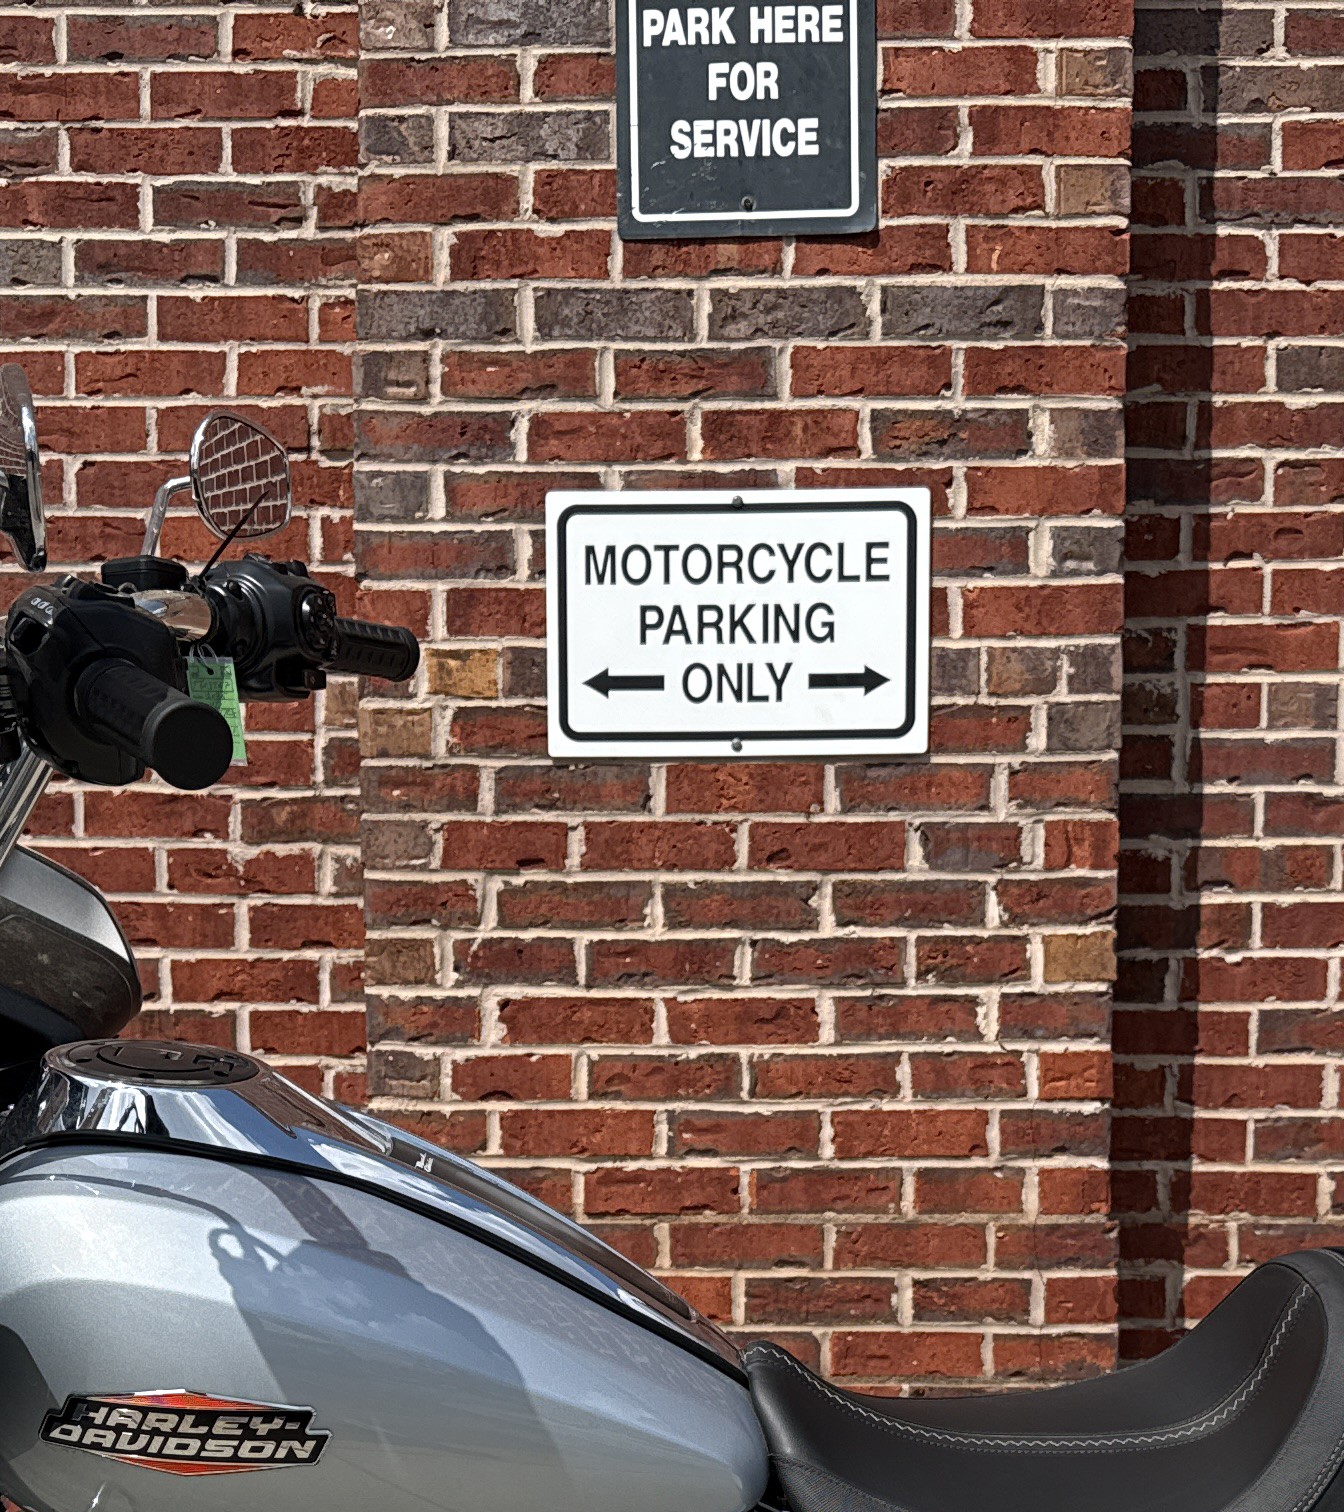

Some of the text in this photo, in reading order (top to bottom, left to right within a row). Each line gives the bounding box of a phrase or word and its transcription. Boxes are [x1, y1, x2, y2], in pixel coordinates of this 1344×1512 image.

[642, 5, 844, 47] PARK HERE
[708, 61, 779, 101] FOR
[669, 117, 820, 160] SERVICE
[584, 541, 891, 586] MOTORCYCLE
[638, 602, 836, 646] PARKING
[681, 661, 794, 705] ONLY
[71, 1402, 302, 1435] HARLEY-
[48, 1423, 318, 1460] DAVIDSON
